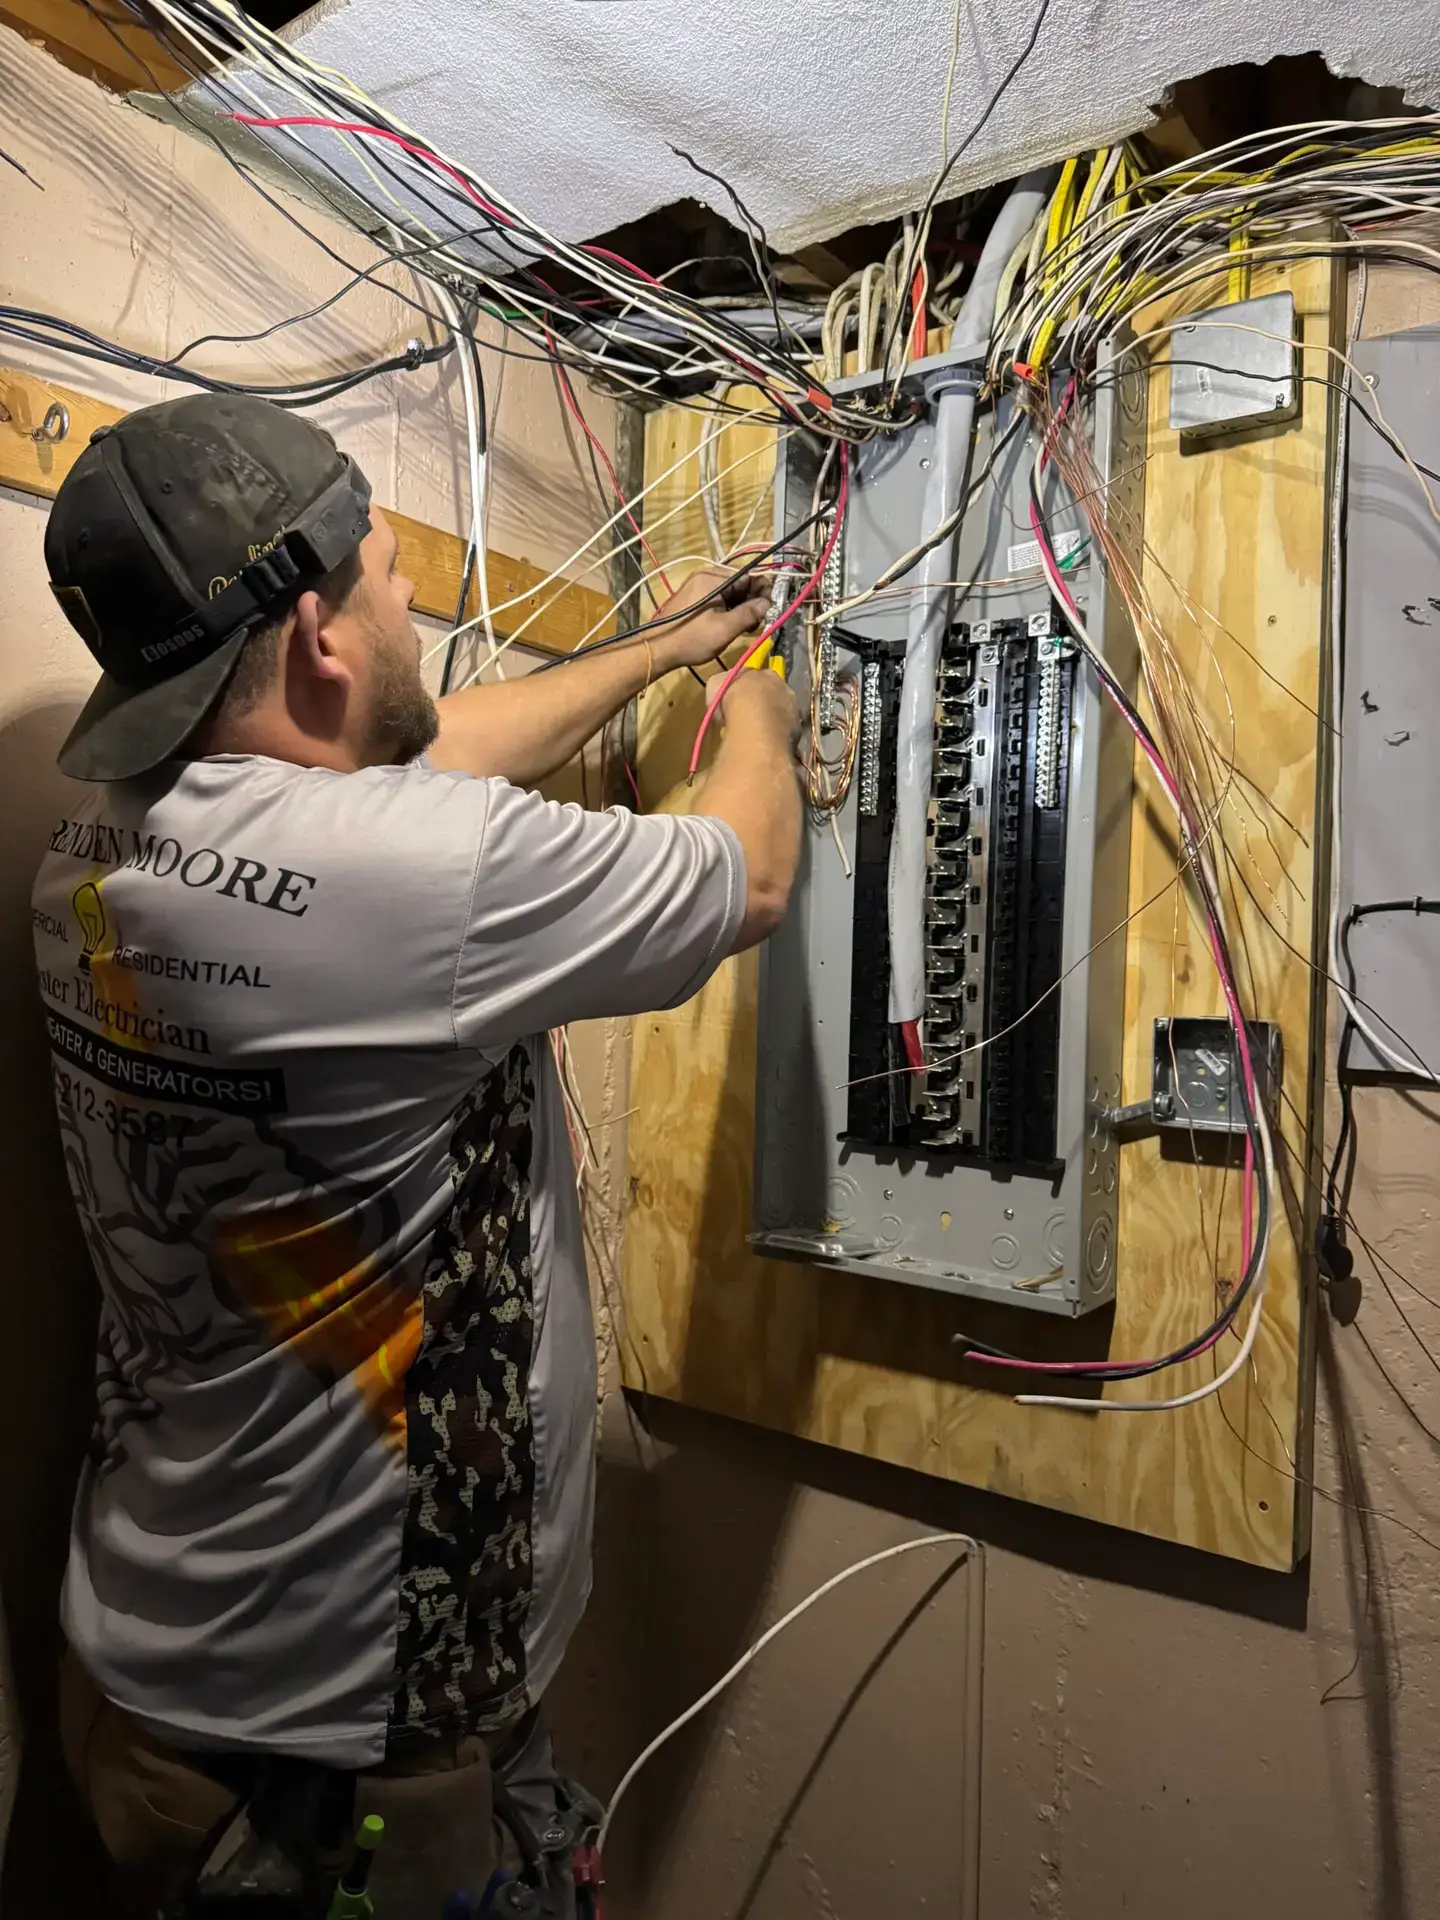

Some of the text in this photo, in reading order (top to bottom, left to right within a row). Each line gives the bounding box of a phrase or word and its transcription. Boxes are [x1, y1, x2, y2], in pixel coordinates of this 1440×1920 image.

[126, 830, 317, 918] MOORE
[112, 946, 272, 988] RESIDENTIAL
[74, 976, 212, 1055] Electrician
[85, 1041, 93, 1063] &
[97, 1048, 272, 1101] GENERATORS!
